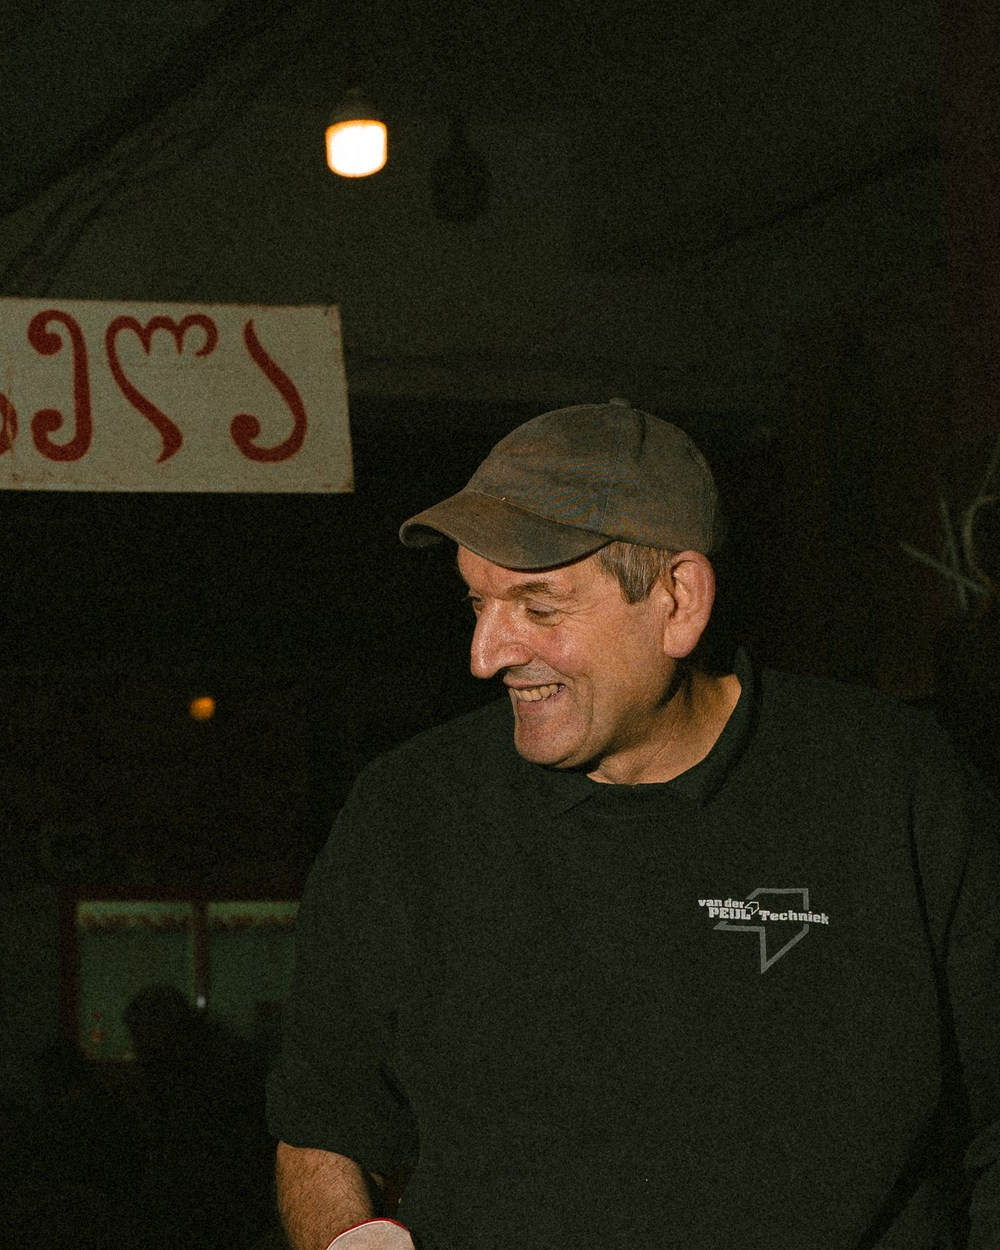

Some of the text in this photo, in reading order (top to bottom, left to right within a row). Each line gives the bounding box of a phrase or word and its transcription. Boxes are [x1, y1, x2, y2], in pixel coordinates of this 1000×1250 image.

[698, 898, 745, 909] van der
[759, 910, 829, 925] Techniek
